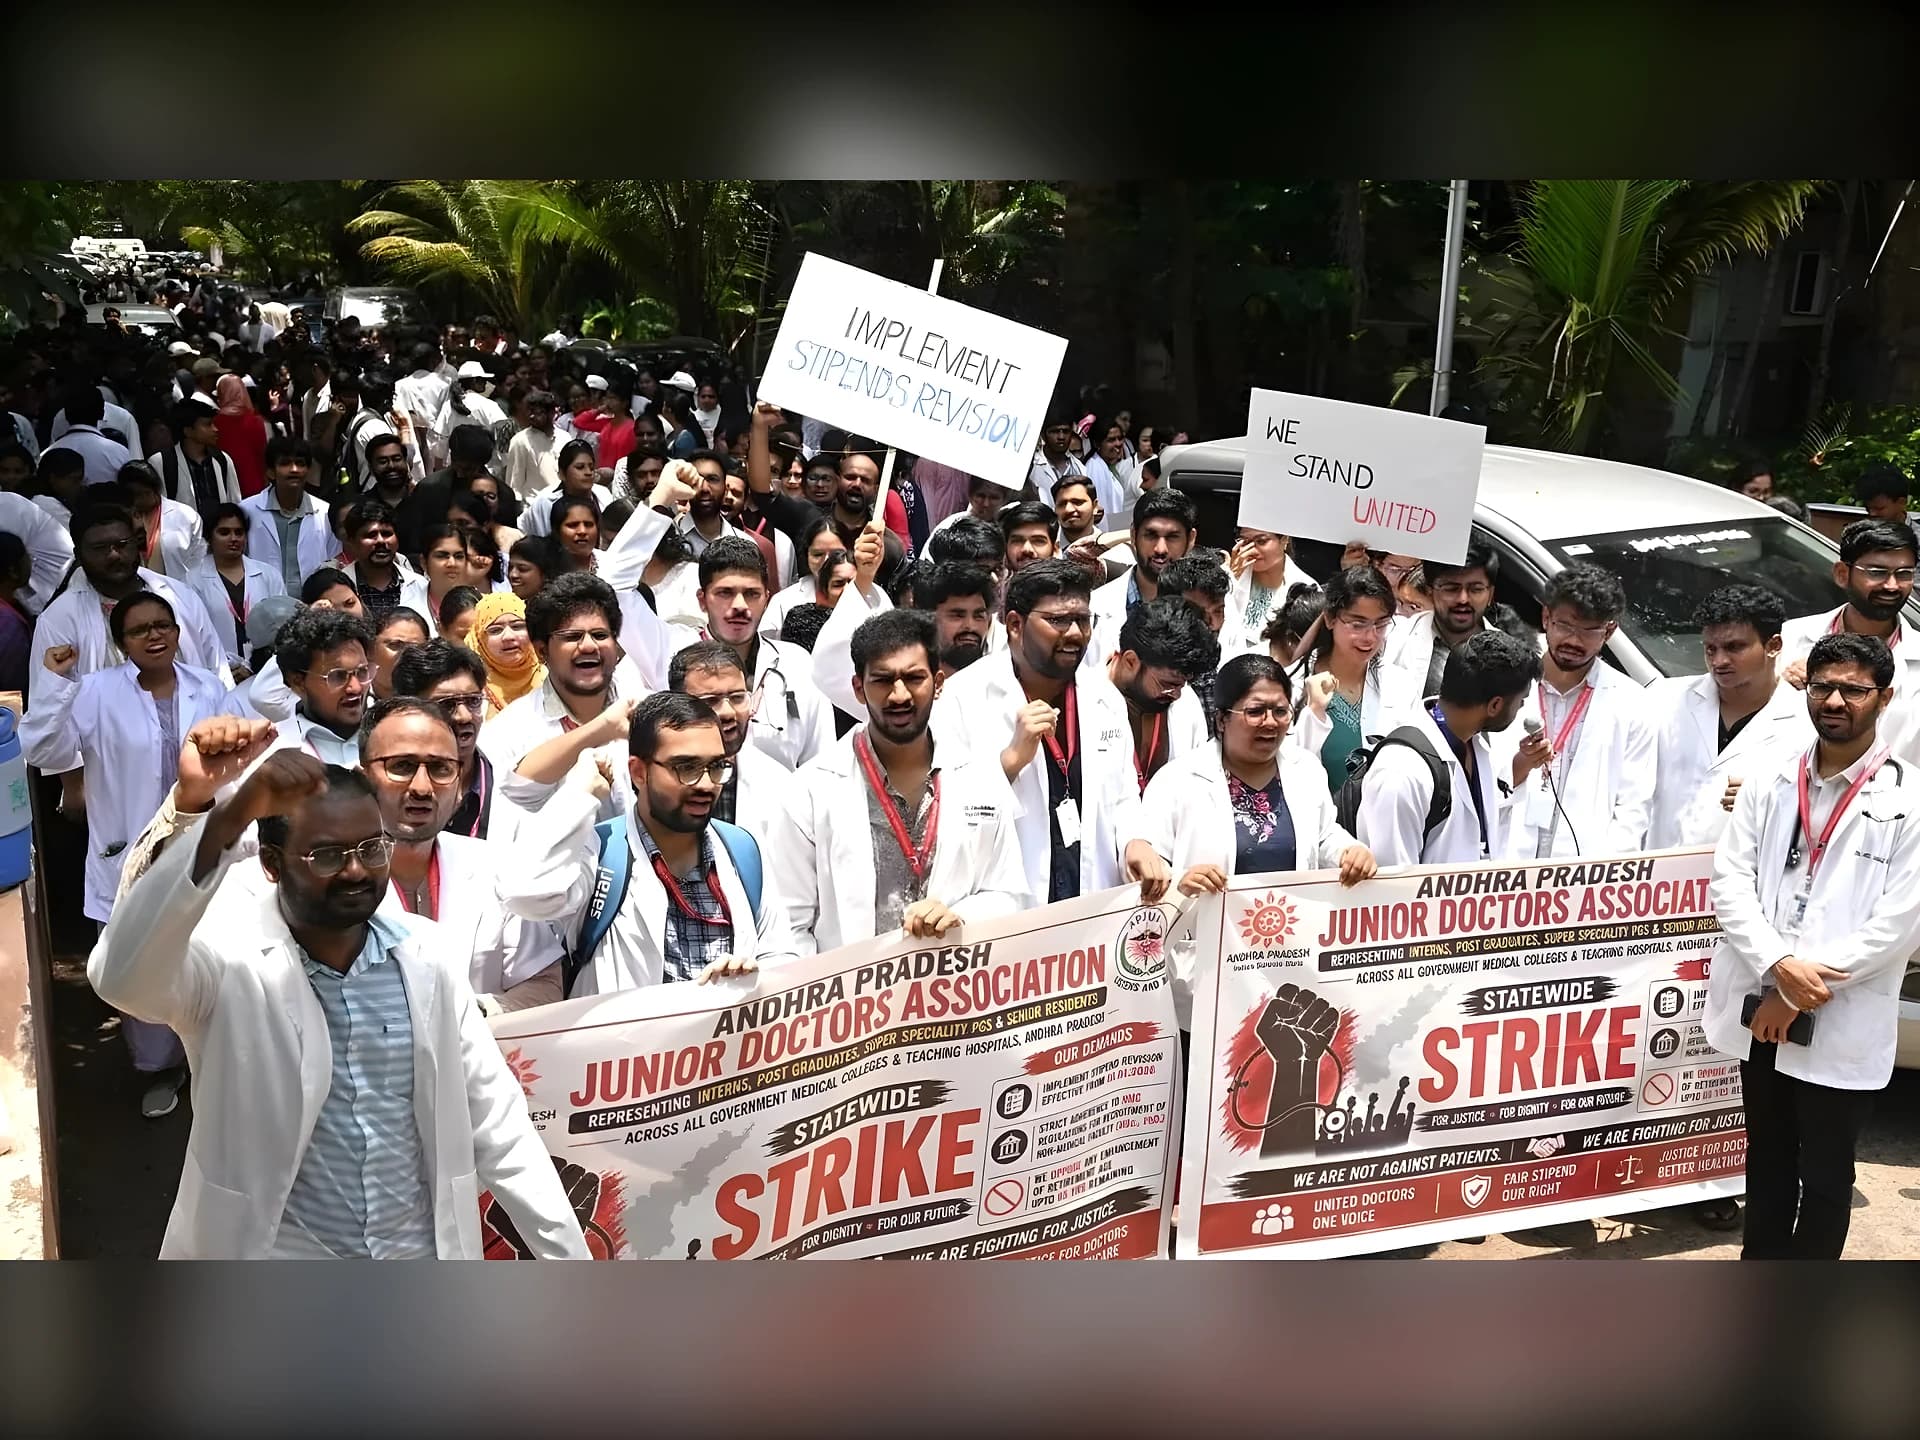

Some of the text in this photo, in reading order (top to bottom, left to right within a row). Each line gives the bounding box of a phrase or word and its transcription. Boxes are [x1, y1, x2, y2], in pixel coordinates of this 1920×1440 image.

[844, 306, 1021, 394] IMPLEMENT
[788, 339, 1032, 453] STIPENDS REVISION
[1266, 416, 1300, 445] WE
[1288, 454, 1374, 489] STAND
[1353, 496, 1437, 534] UNITED
[590, 866, 615, 920] safari
[1416, 859, 1655, 899] ANDHRA PRADESH
[1318, 901, 1428, 947] JUNIOR
[1439, 888, 1570, 936] DOCTORS
[1266, 947, 1310, 959] PRADESH
[1330, 947, 1404, 967] REPRESENTING
[1456, 939, 1481, 953] POST
[1543, 930, 1575, 945] SUPER
[1652, 923, 1660, 934] &
[1356, 969, 1395, 985] ACROSS
[1398, 967, 1415, 981] ALL
[1482, 954, 1520, 971] MEDICAL
[1524, 949, 1568, 967] COLLEGES
[1570, 949, 1578, 961] &
[712, 942, 993, 1038] ANDHRA PRADESH
[1483, 980, 1595, 1011] STATEWIDE
[569, 943, 1106, 1107] JUNIOR DOCTORS ASSOCIATION
[588, 1094, 691, 1128] REPRESENTING
[698, 1077, 752, 1105] INTERNS,
[757, 1065, 789, 1088] POST
[863, 1032, 897, 1054] SUPER
[995, 1015, 1004, 1029] &
[1006, 1005, 1042, 1026] SENIOR
[1045, 992, 1098, 1016] RESIDENTS
[1054, 1027, 1134, 1066] OUR DEMANDS
[1418, 1005, 1642, 1103] STRIKE
[624, 1122, 679, 1145] ACROSS
[683, 1115, 706, 1133] ALL
[709, 1090, 788, 1125] GOVERNMENT
[791, 1076, 838, 1101] MEDICAL
[841, 1056, 889, 1084] COLLEGES
[892, 1053, 901, 1066] &
[906, 1045, 961, 1064] TEACHING
[965, 1034, 1022, 1058] HOSPITALS,
[1024, 1023, 1064, 1044] ANDHRA
[793, 1084, 922, 1146] STATEWIDE
[1431, 1114, 1449, 1127] FOR
[1451, 1110, 1486, 1125] JUSTICE
[1499, 1107, 1515, 1119] FOR
[1517, 1101, 1550, 1117] DIGNITY
[1560, 1098, 1576, 1111] FOR
[1577, 1095, 1595, 1109] OUR
[1583, 1132, 1603, 1149] WE
[1604, 1128, 1631, 1146] ARE
[1632, 1121, 1687, 1142] FIGHTING
[1688, 1117, 1711, 1133] FOR
[1293, 1147, 1502, 1188] WE ARE NOT AGAINST PATIENTS.
[1531, 1163, 1577, 1182] STIPEND
[1657, 1162, 1695, 1178] BETTER
[1659, 1145, 1700, 1163] JUSTICE
[712, 1108, 982, 1260] STRIKE
[1032, 1184, 1045, 1197] OF
[1313, 1187, 1416, 1213] UNITED DOCTORS
[1502, 1181, 1562, 1202] OUR RIGHT
[801, 1203, 961, 1252] FOR DIGNITY FOR OUR FUTURE
[939, 1244, 970, 1260] ARE
[972, 1228, 1039, 1257] FIGHTING
[1042, 1221, 1068, 1240] FOR
[1071, 1199, 1118, 1232] JUSTICE.
[1312, 1208, 1376, 1231] ONE VOICE
[1058, 1244, 1081, 1260] FOR
